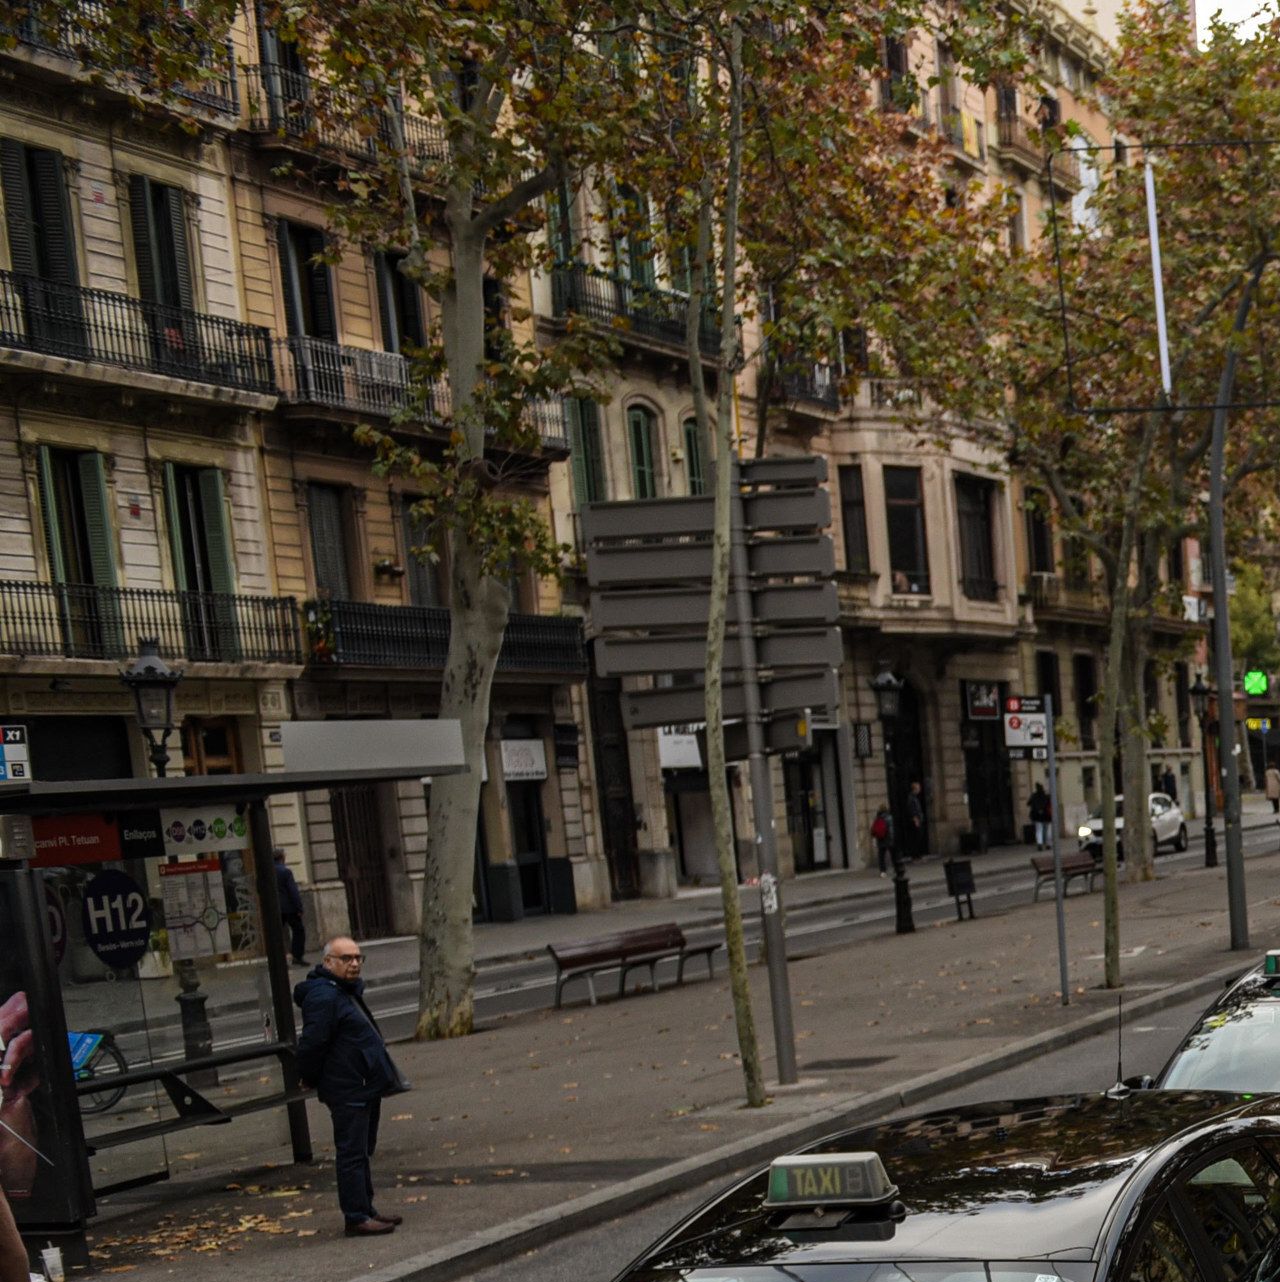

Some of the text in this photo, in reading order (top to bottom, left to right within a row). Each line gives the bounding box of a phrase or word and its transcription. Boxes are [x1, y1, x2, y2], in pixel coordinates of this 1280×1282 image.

[6, 730, 20, 741] X1
[35, 840, 57, 849] canvi
[71, 835, 100, 846] Tetuan
[123, 828, 157, 842] Enllaços
[87, 891, 147, 934] H12
[793, 1166, 841, 1195] TAXI
